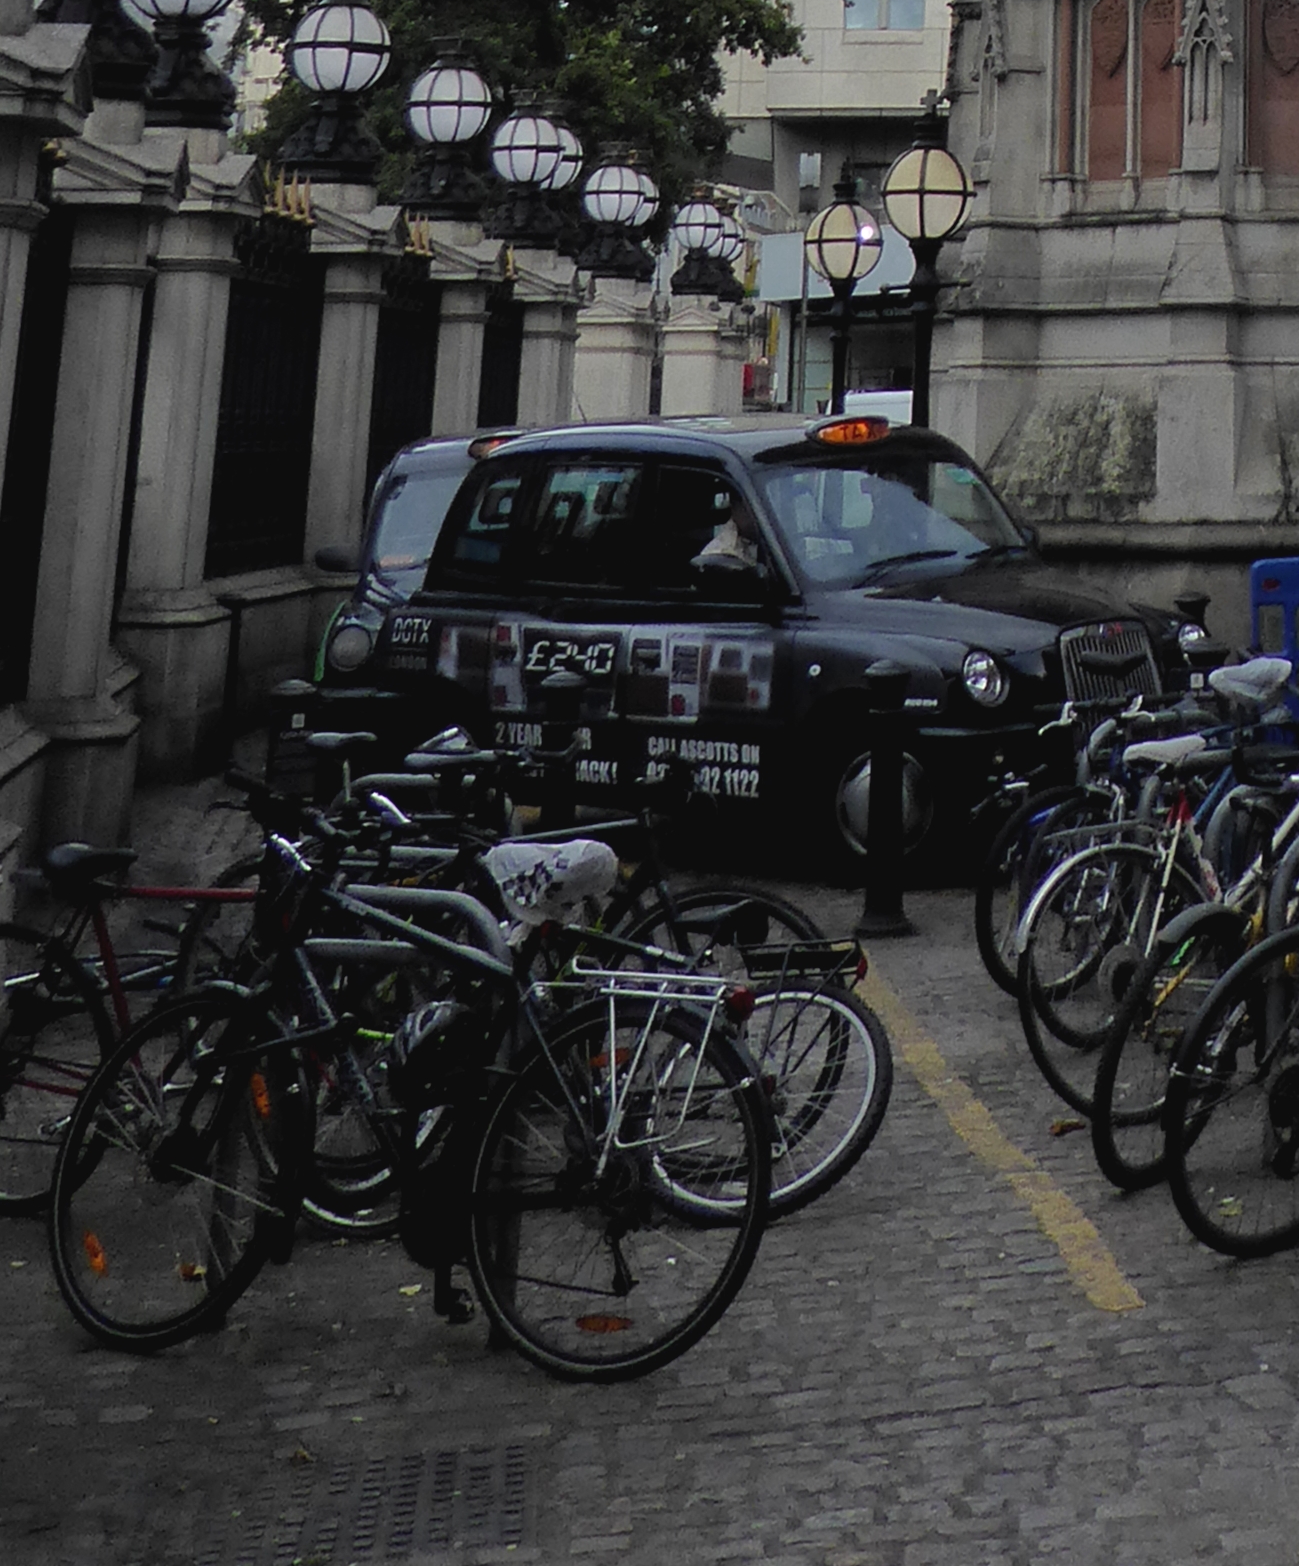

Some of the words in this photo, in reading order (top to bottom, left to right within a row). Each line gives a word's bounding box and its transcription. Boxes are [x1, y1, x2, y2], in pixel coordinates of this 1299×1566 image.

[525, 639, 615, 674] £240
[494, 721, 505, 744] 2
[507, 722, 542, 747] YEAR
[679, 739, 739, 763] ASCOTTS
[740, 744, 761, 765] ON
[723, 768, 760, 799] 1122
